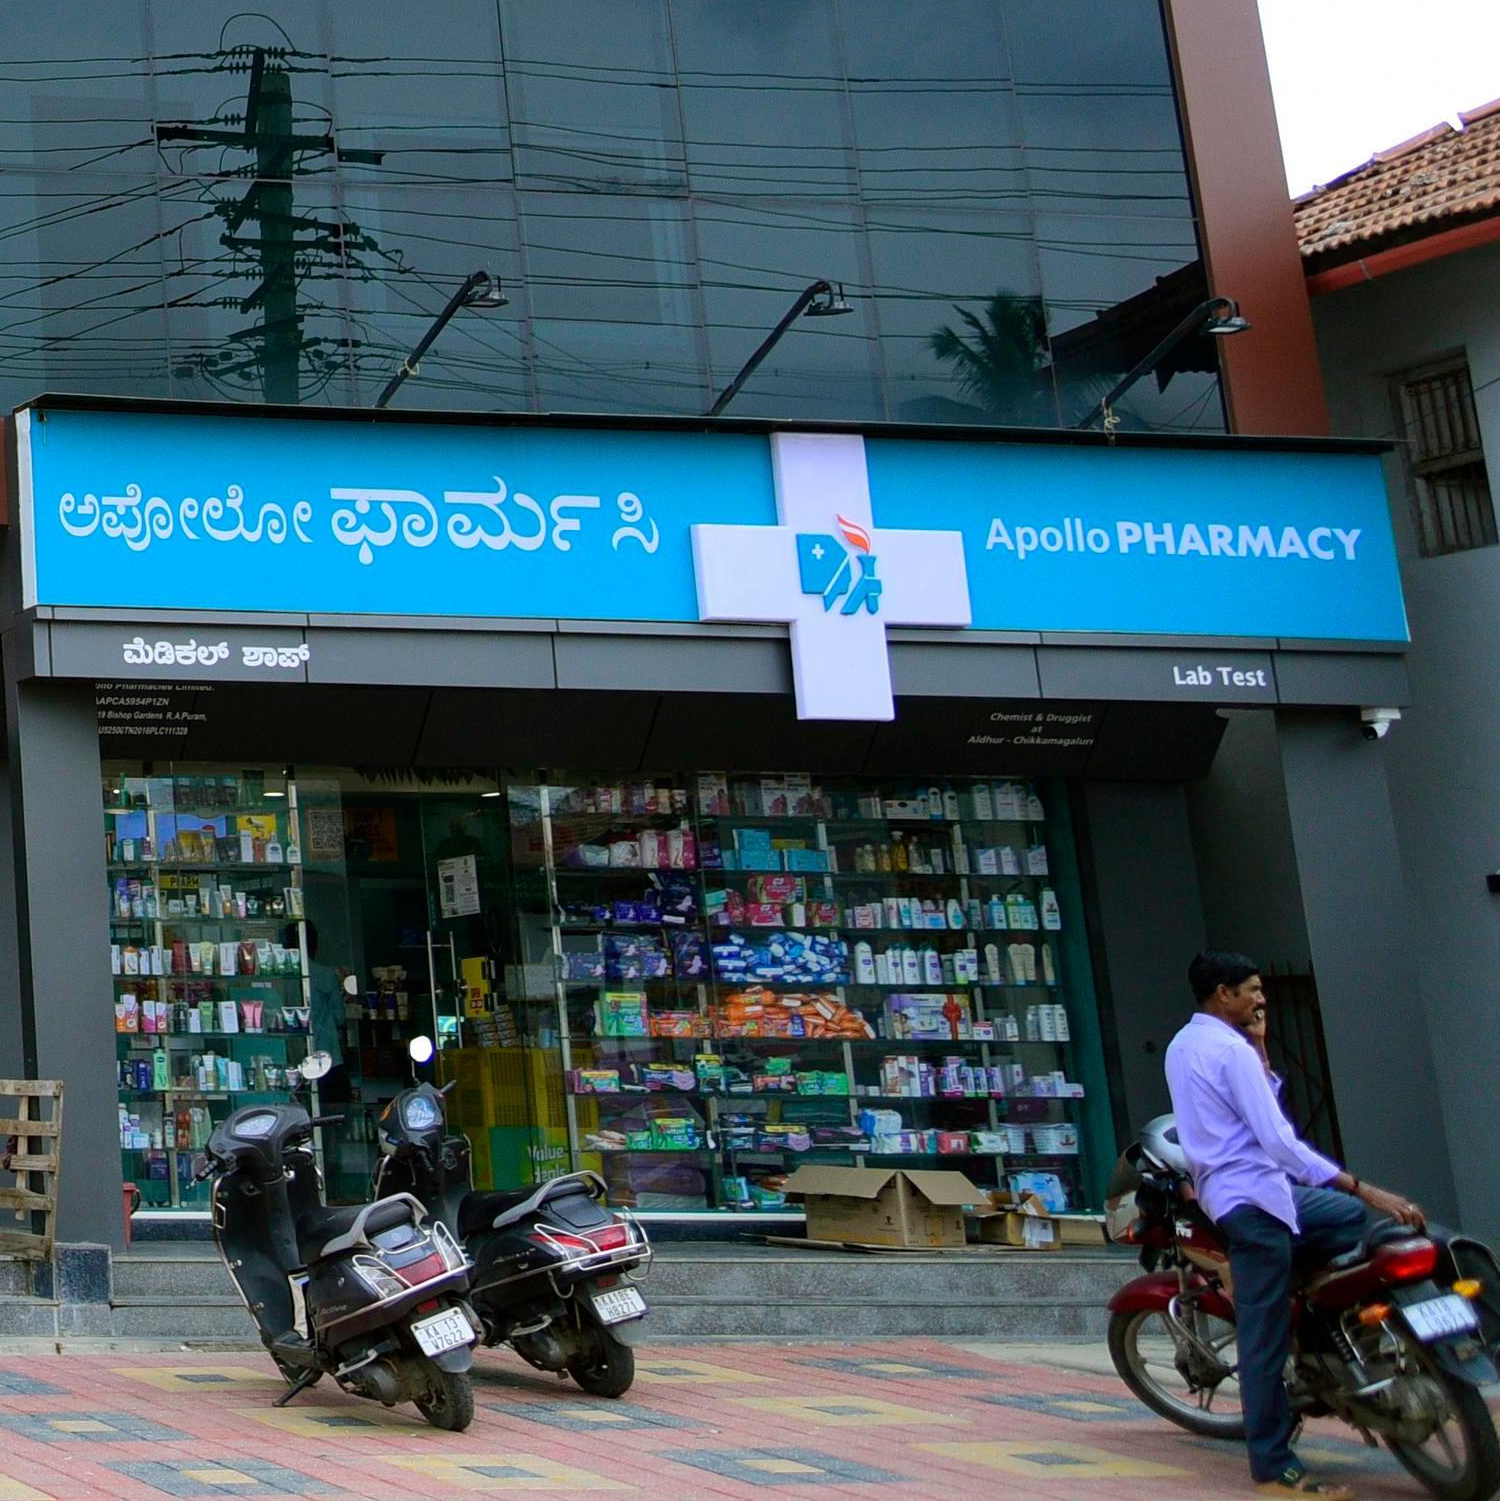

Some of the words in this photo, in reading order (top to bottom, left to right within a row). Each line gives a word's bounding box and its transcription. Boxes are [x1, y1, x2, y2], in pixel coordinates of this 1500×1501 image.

[59, 483, 314, 552] ಅಪೋಲೋ
[985, 517, 1110, 562] Apollo
[1118, 521, 1363, 561] PHARMACY
[123, 637, 229, 665] ಮೆಡಿಕಲ್
[242, 644, 310, 668] ಶಾಪ್
[1172, 665, 1211, 686] Lab
[1216, 666, 1266, 686] Test
[107, 710, 132, 720] Bishop
[133, 710, 163, 720] Gardens
[990, 711, 1033, 722] Chemist
[1034, 712, 1044, 722] &
[1046, 712, 1092, 724] Druggist
[1031, 724, 1043, 733] at
[967, 735, 1004, 745] Aldhur
[527, 1143, 564, 1161] Value
[424, 1325, 440, 1339] KA
[443, 1317, 459, 1332] 13
